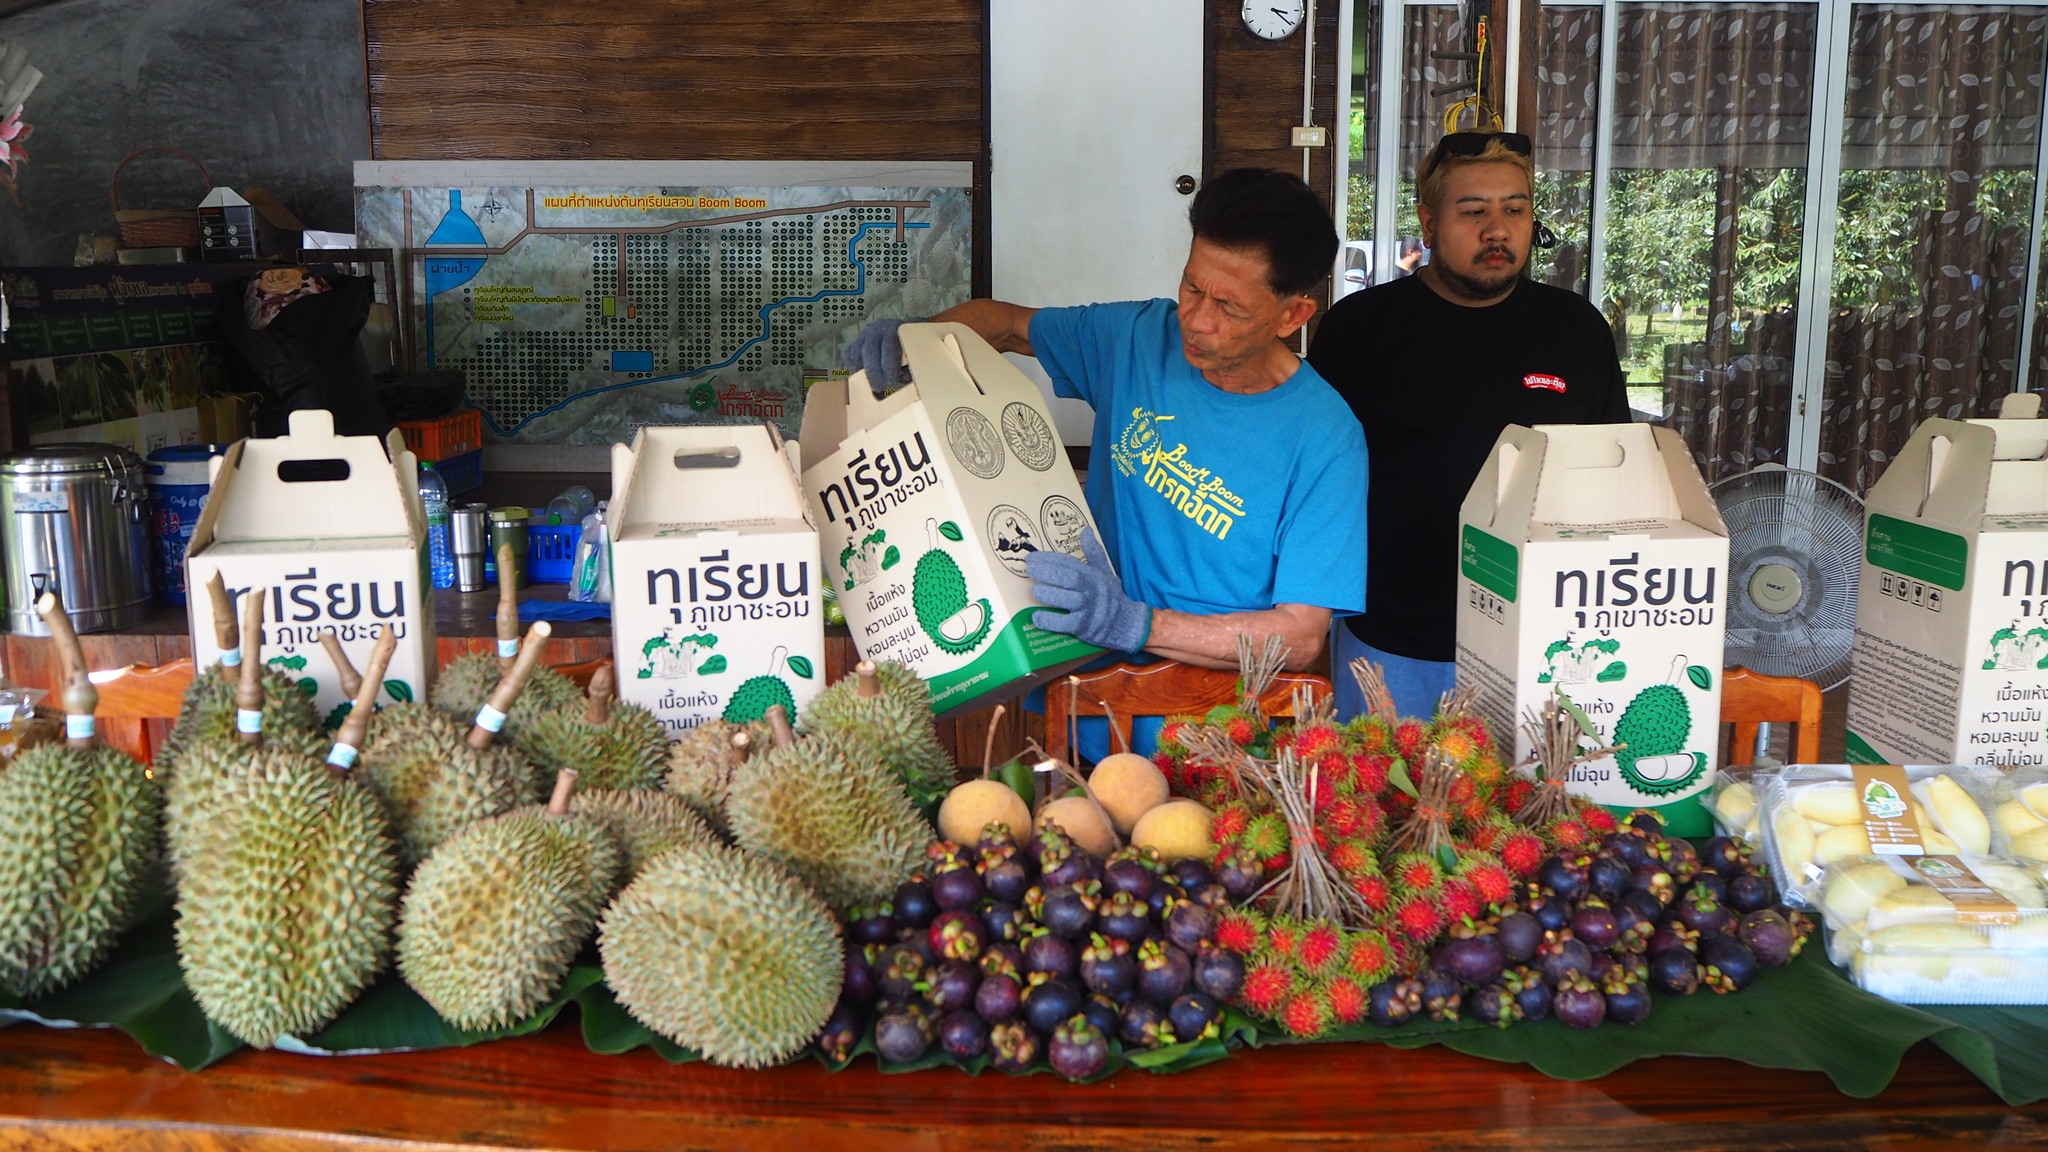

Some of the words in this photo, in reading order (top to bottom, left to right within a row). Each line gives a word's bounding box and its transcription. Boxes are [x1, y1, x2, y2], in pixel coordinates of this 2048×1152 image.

[544, 192, 694, 212] แผนที่ตำแหน่งต้นทุเรียนสวน
[699, 197, 730, 208] Boom
[734, 197, 766, 208] Boom
[431, 261, 469, 274] ฝายน้ำ
[818, 430, 932, 533] ทุเรียน
[858, 466, 938, 531] ภูเขาชะอม
[647, 549, 809, 625] ทุเรียน
[866, 583, 907, 613] เนื้อแห้ง
[1554, 552, 1716, 629] ทุเรียน
[690, 600, 810, 632] ภูเขาชะอม
[865, 605, 909, 637] หวานมัน
[1594, 608, 1714, 637] ภูเขาชะอม
[866, 625, 916, 658] หอมละมุน
[659, 688, 719, 710] เนื้อแห้ง
[1981, 707, 2042, 723] หวานมัน
[1970, 731, 2040, 748] หอมละมุน
